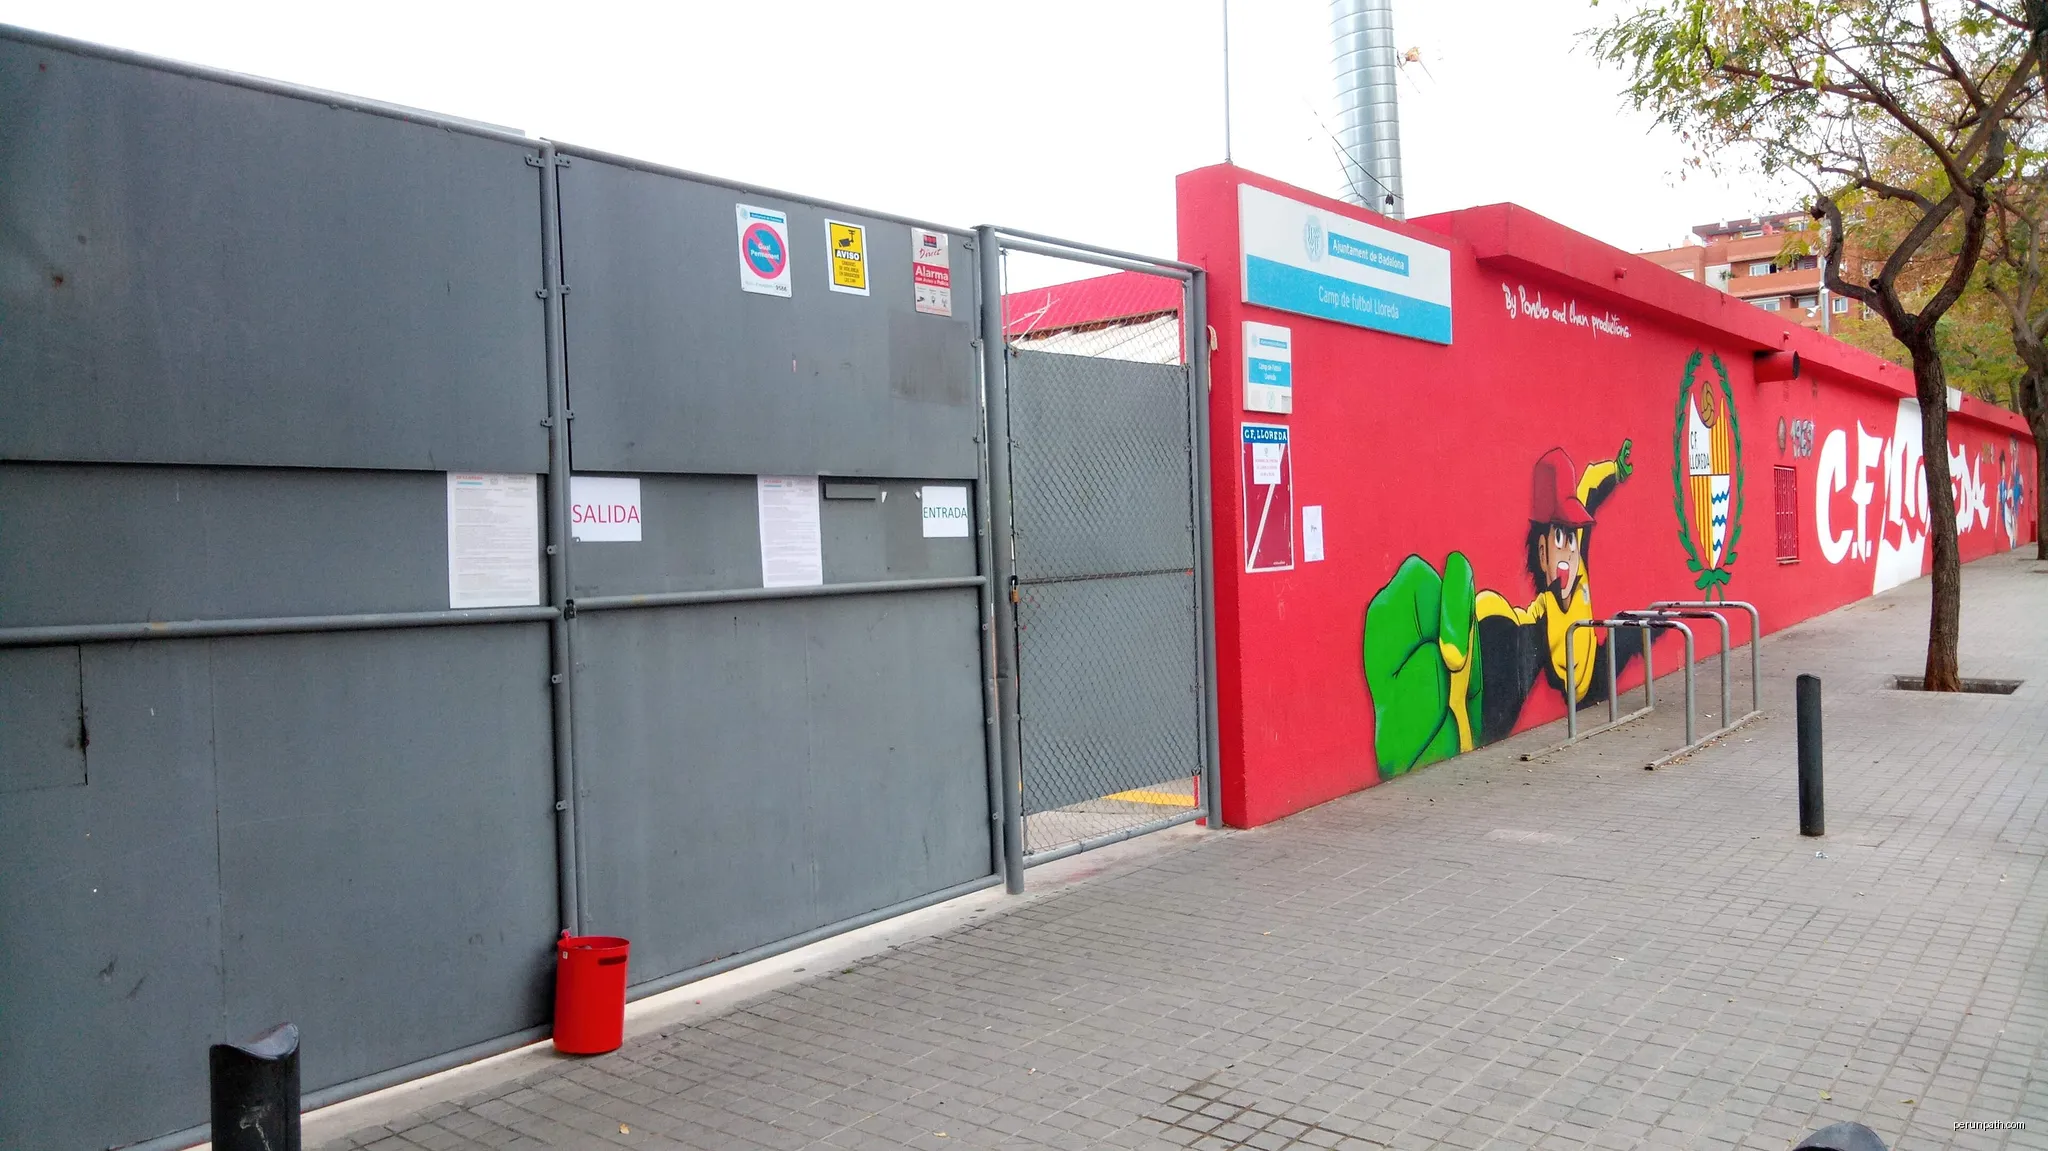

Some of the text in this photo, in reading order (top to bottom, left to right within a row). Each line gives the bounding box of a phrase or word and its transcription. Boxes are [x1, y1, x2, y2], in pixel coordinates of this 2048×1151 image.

[836, 250, 860, 260] AVISO
[919, 247, 942, 259] Direct
[1332, 239, 1405, 271] Ajuntament de Badalona
[915, 265, 949, 281] Alarma
[1318, 285, 1400, 319] Camp de futbol Lloreda
[1502, 282, 1516, 319] By
[1518, 284, 1549, 319] Poncho
[1552, 302, 1567, 324] and
[1256, 429, 1287, 441] LLOREDA
[572, 504, 640, 524] SALIDA
[923, 506, 968, 519] ENTRADA
